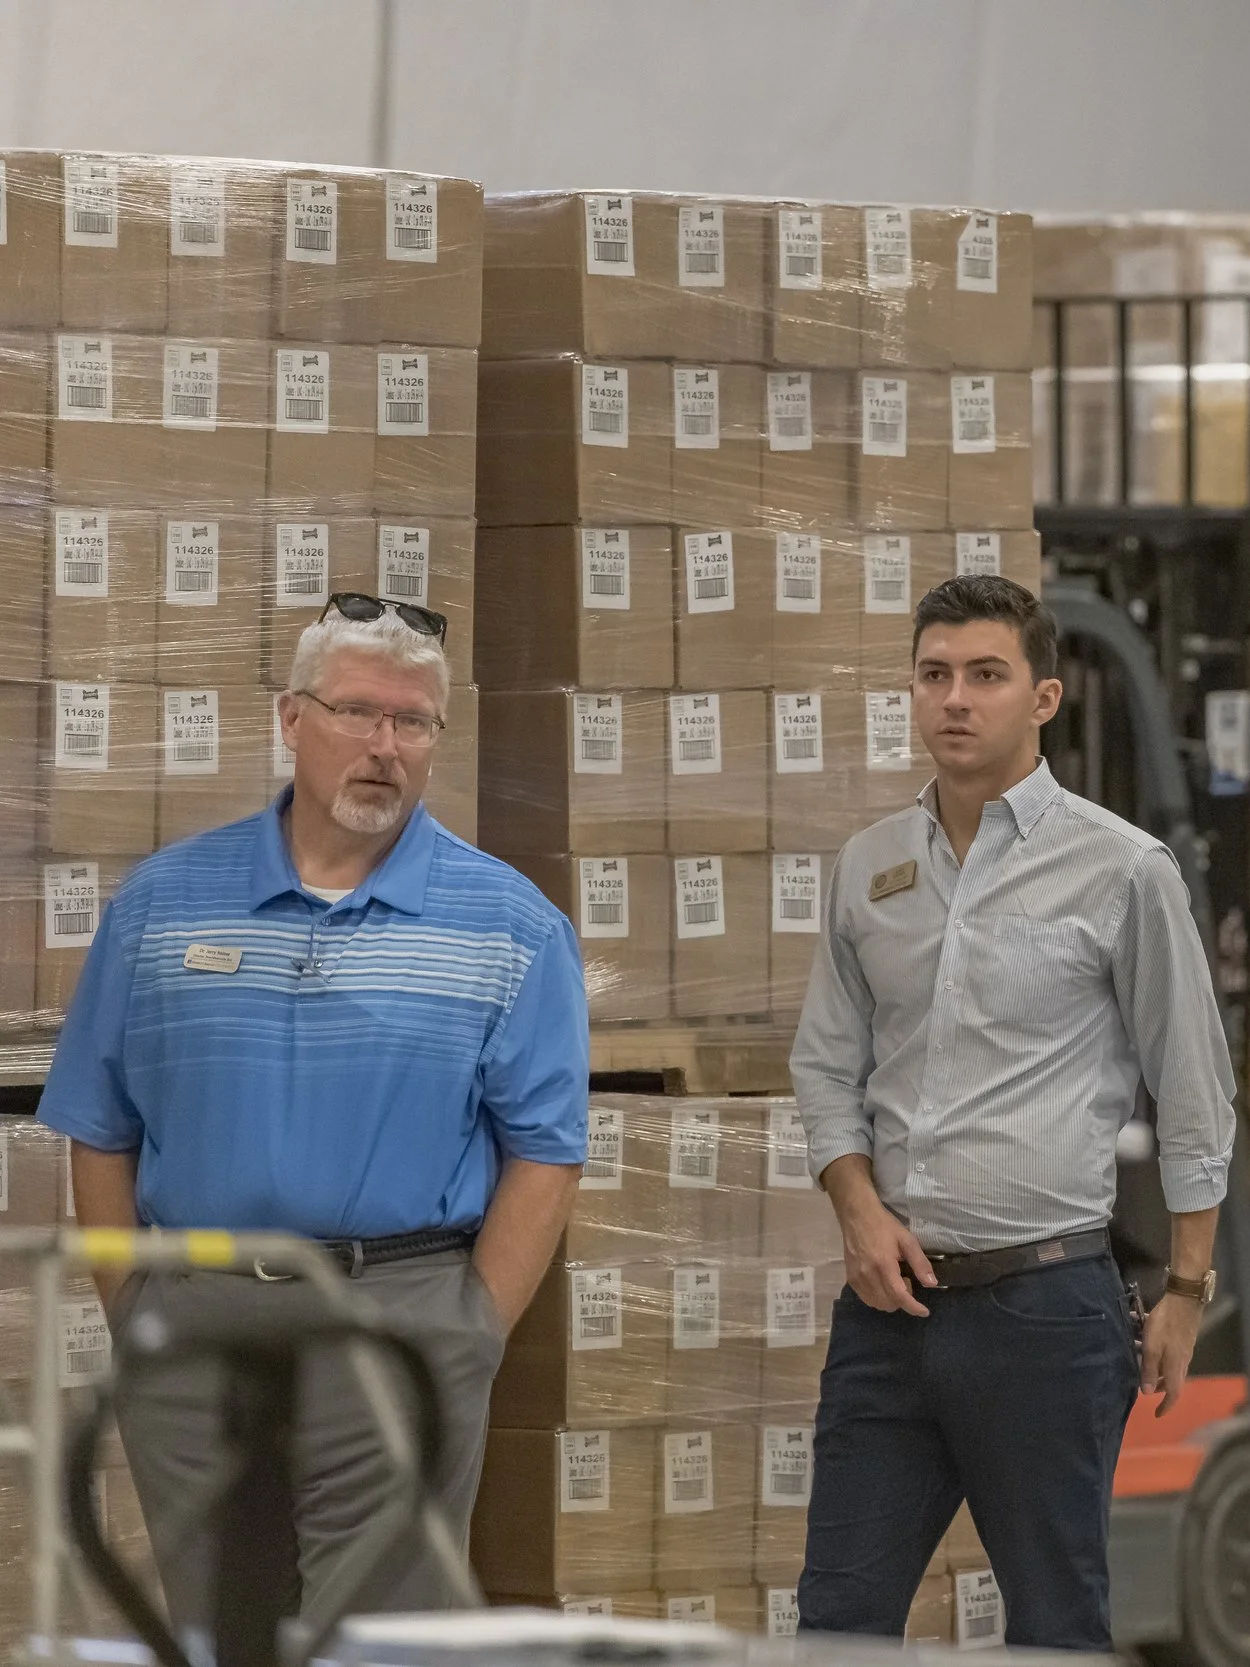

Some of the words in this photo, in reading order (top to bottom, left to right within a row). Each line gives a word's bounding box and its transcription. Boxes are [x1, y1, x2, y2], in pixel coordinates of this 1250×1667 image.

[295, 204, 333, 215] 114326
[394, 203, 433, 214] 114326
[592, 217, 628, 227] 114326
[684, 229, 719, 238] 114326
[973, 236, 993, 245] 4326
[67, 361, 108, 371] 114326
[172, 370, 213, 381] 114326
[285, 374, 325, 384] 114326
[385, 377, 424, 387] 114326
[588, 388, 624, 398] 114326
[680, 391, 715, 400] 114326
[64, 537, 104, 547] 114326
[175, 547, 214, 555] 114326
[285, 548, 324, 557] 114326
[387, 550, 425, 561] 114326
[589, 550, 625, 560] 114326
[693, 553, 729, 564] 114326
[783, 555, 816, 564] 114326
[963, 554, 996, 563] 114326
[65, 709, 104, 719] 114326
[872, 714, 906, 723] 114326
[173, 715, 214, 725] 114326
[581, 715, 617, 725] 114326
[678, 716, 715, 725] 114326
[782, 715, 817, 724] 114326
[587, 879, 624, 889] 114326
[682, 877, 718, 889] 114326
[780, 875, 816, 884] 114326
[54, 887, 95, 897] 114326
[588, 1133, 619, 1142] 14326
[580, 1292, 617, 1302] 114326
[65, 1325, 106, 1336] 114326
[569, 1454, 606, 1464] 114326
[771, 1450, 808, 1459] 114326
[672, 1455, 708, 1465] 114326
[775, 1612, 799, 1620] 1143
